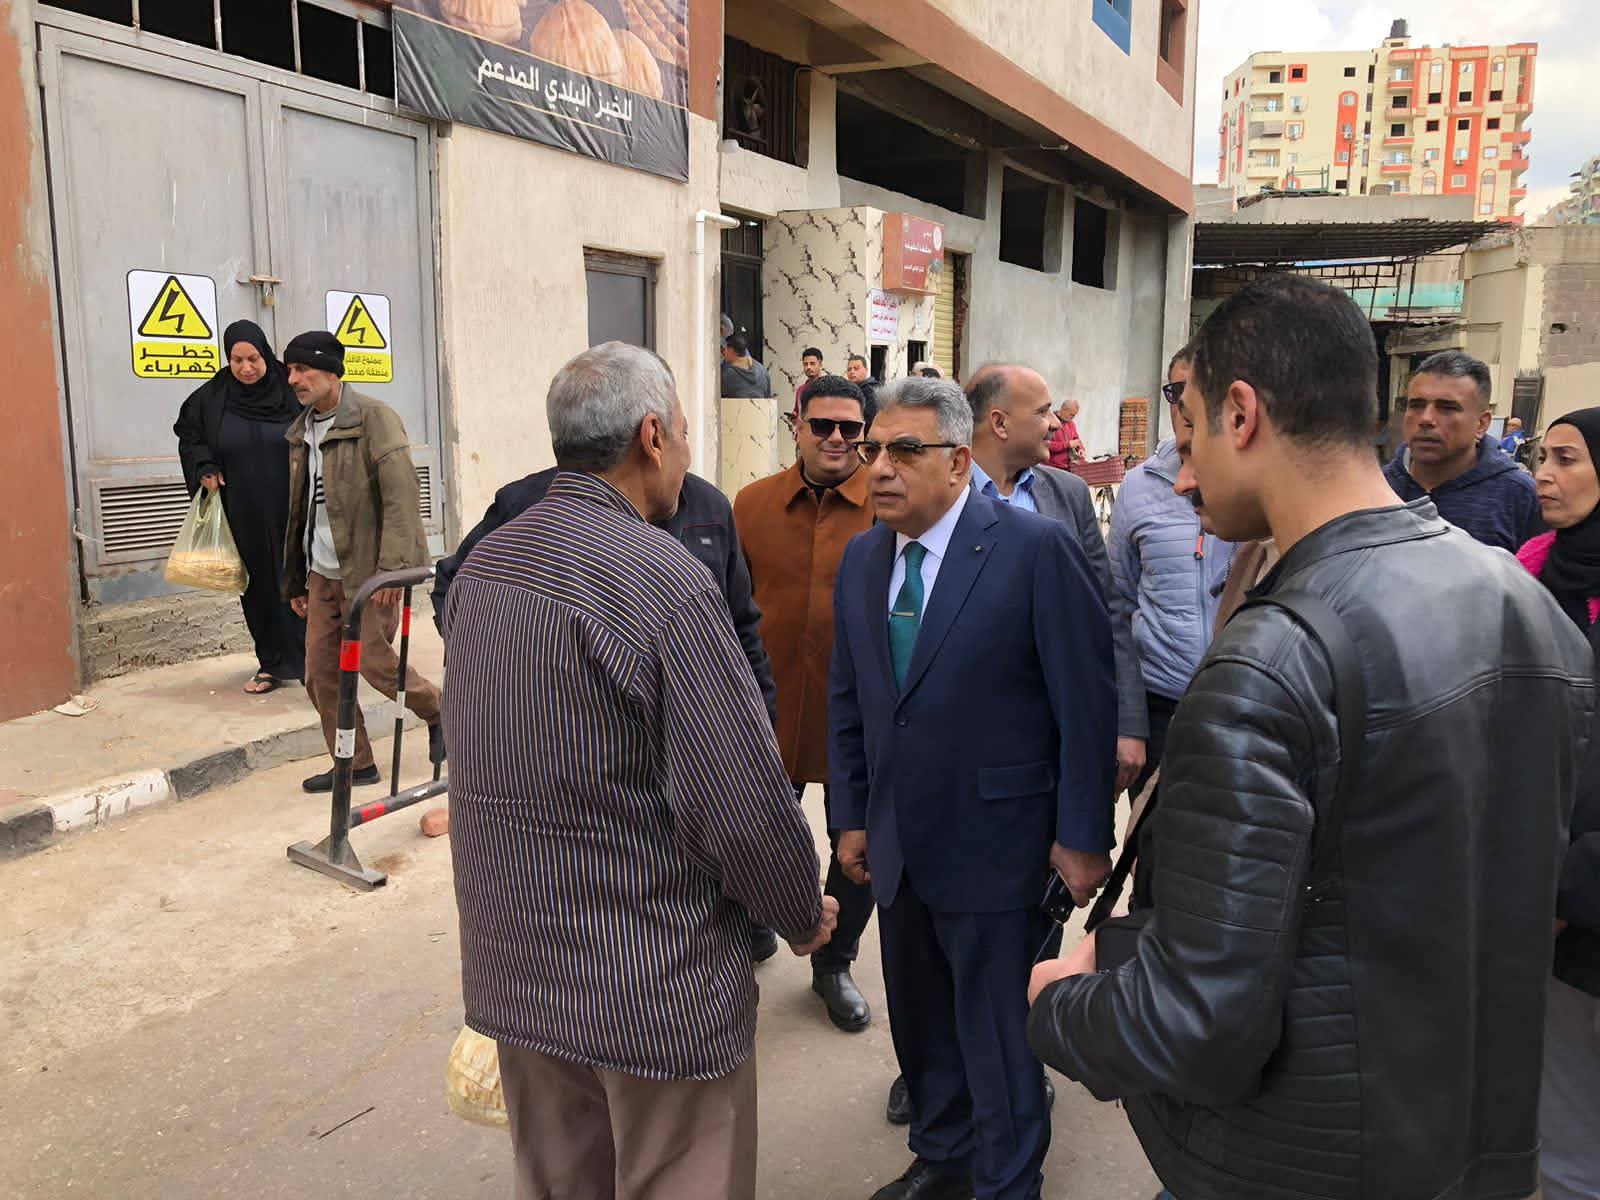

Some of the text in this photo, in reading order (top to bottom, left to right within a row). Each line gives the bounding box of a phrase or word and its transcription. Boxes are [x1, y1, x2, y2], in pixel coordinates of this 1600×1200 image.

[478, 58, 633, 122] للخبز البلدي المدعم
[140, 345, 215, 360] خطر
[144, 360, 217, 375] كهرباء
